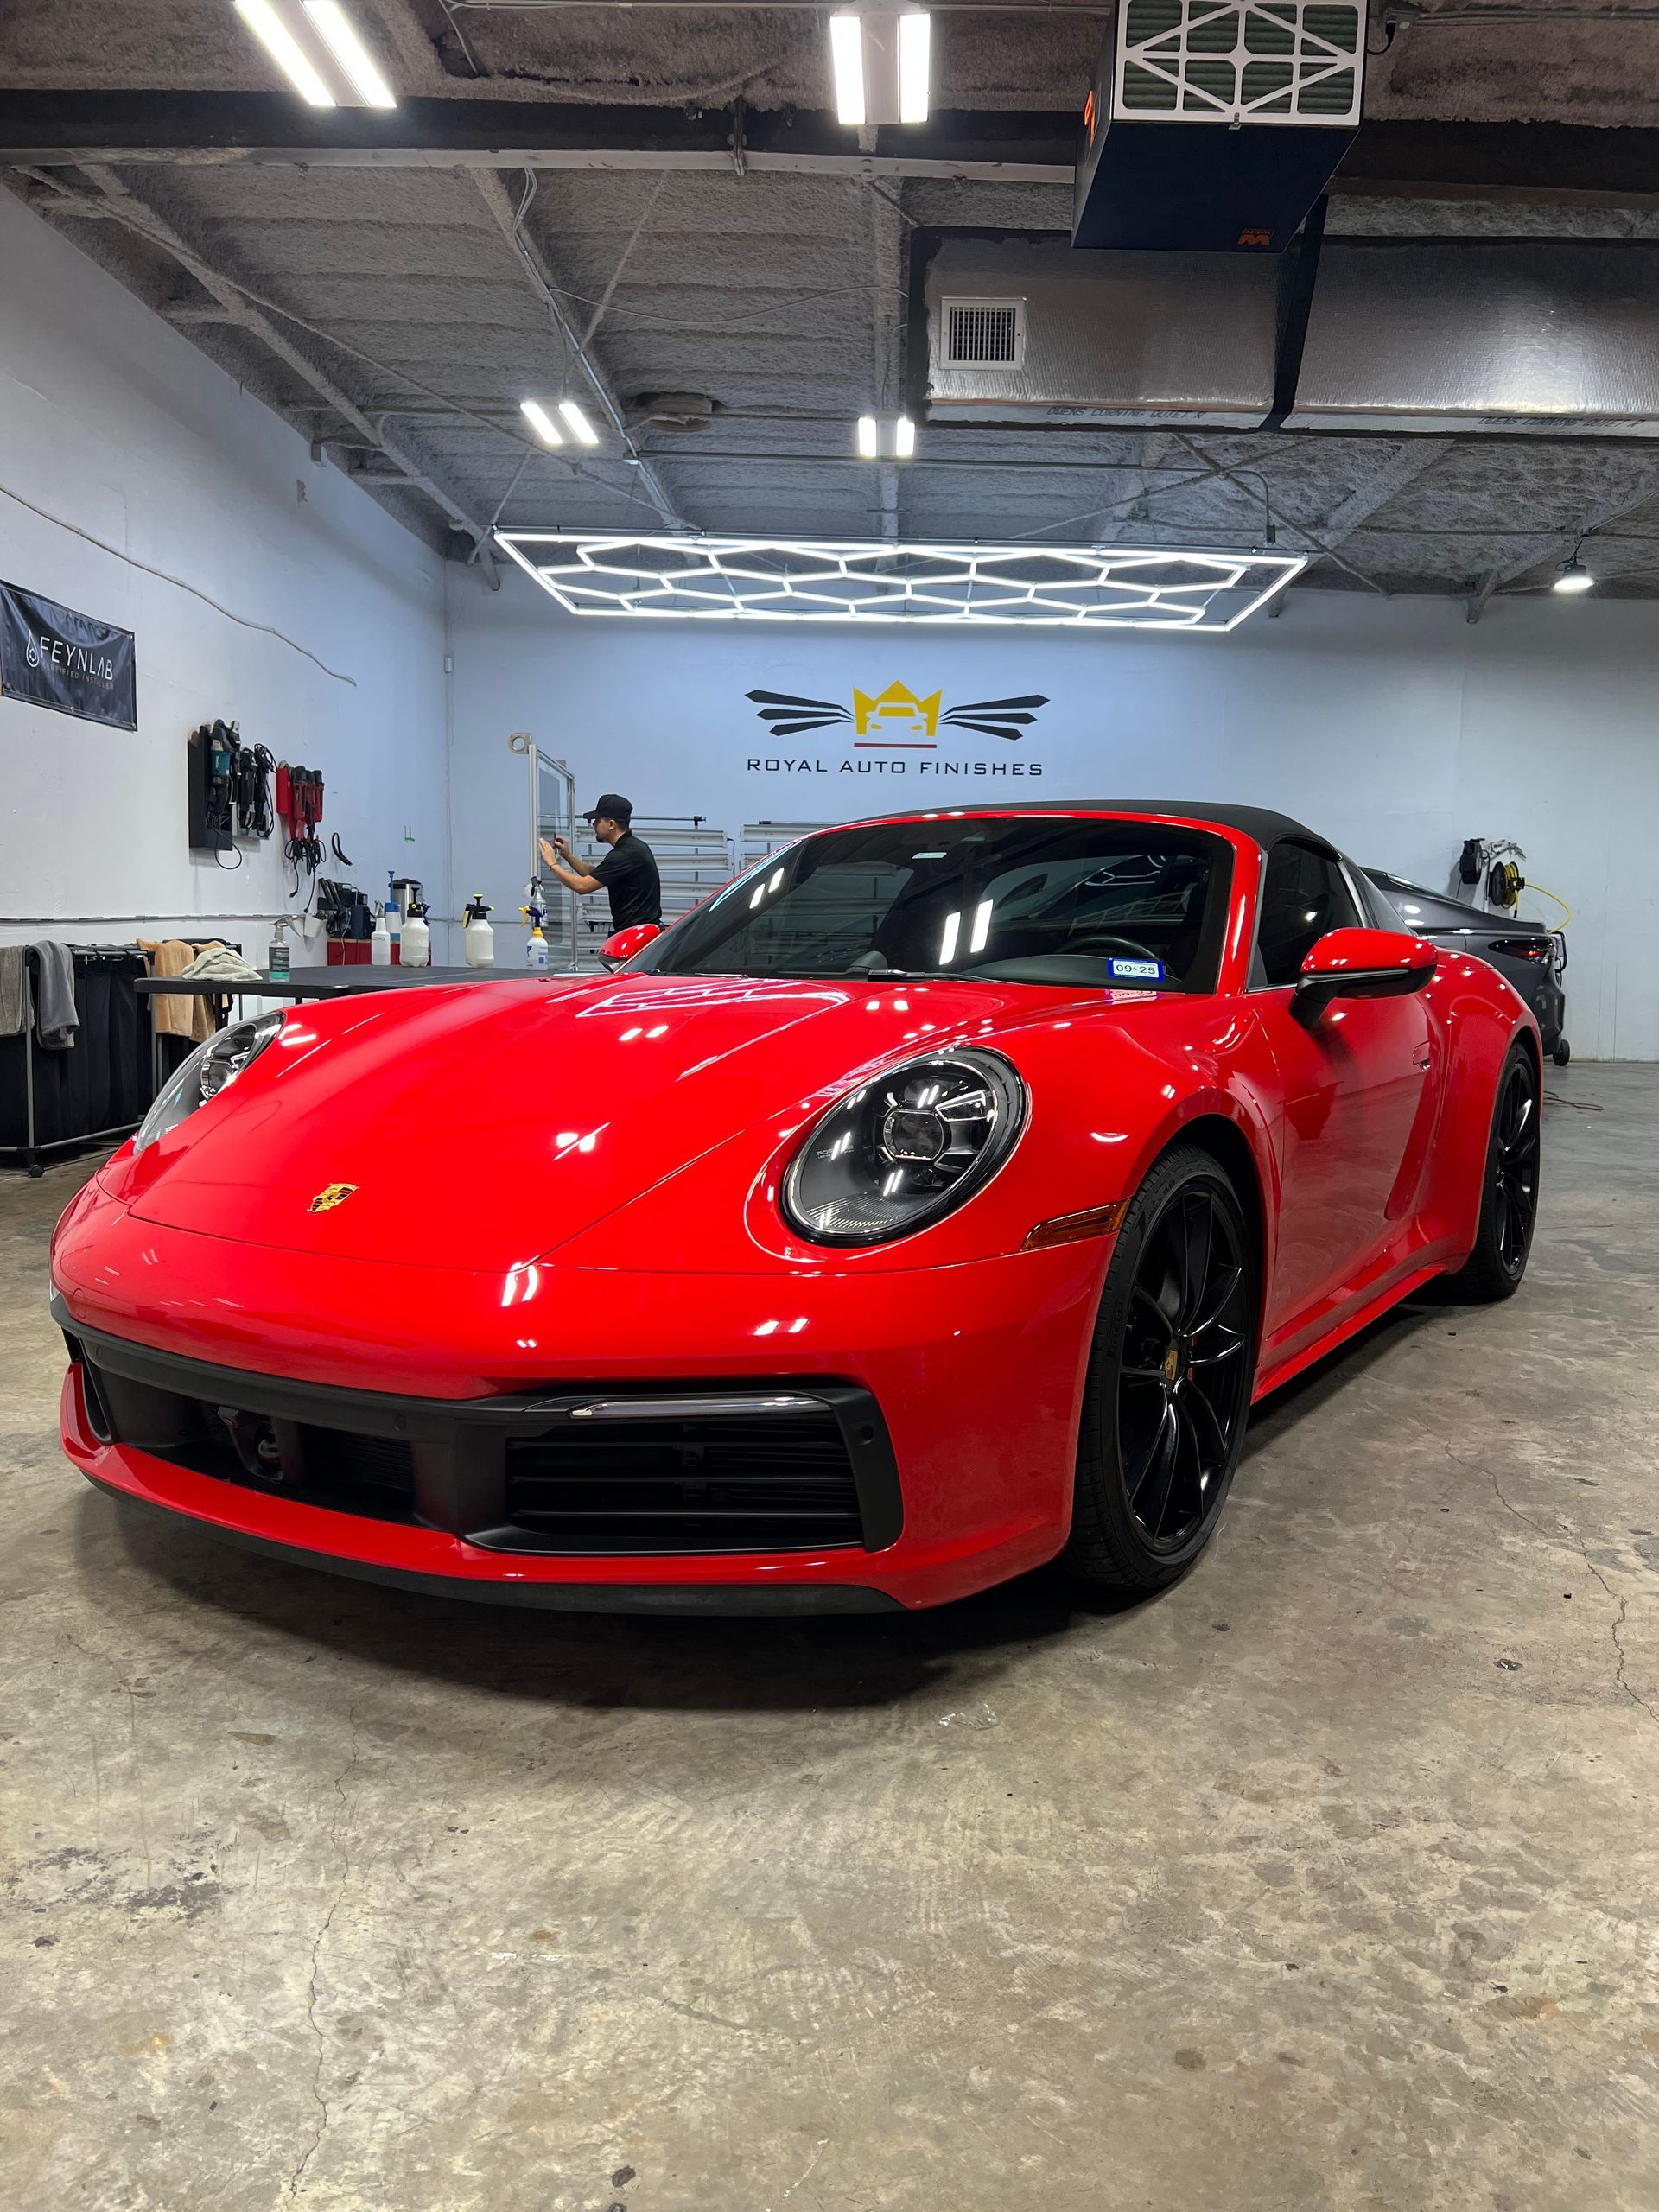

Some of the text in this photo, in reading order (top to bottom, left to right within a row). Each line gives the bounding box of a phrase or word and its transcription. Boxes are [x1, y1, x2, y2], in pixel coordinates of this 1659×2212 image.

[40, 636, 113, 681] FEYNLAB
[42, 662, 79, 679] ERTIFIED
[747, 759, 1043, 776] ROYAL AUTO FINISHES
